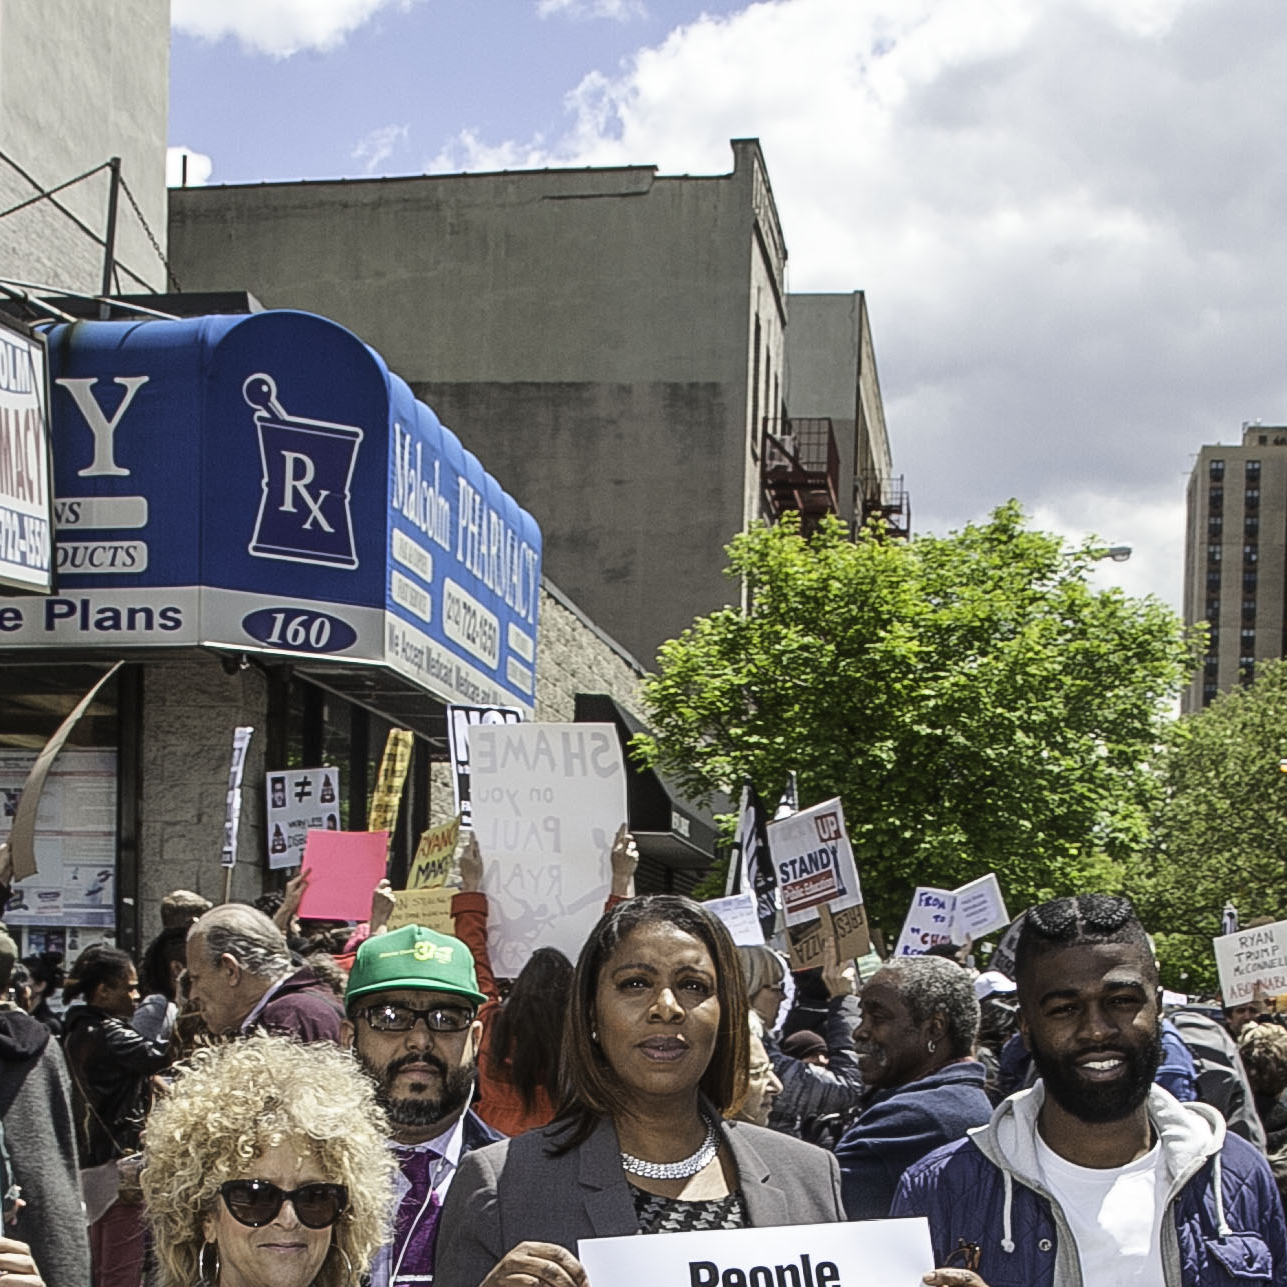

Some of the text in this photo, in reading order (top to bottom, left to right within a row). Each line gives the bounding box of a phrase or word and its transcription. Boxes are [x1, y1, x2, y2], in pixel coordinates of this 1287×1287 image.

[392, 422, 538, 624] Malcolm PHARMACY
[44, 598, 183, 632] Plans
[266, 612, 331, 648] 160
[817, 816, 839, 840] UP
[779, 848, 831, 883] STAND
[1234, 945, 1280, 963] TRUMP
[1238, 930, 1275, 949] RYAN
